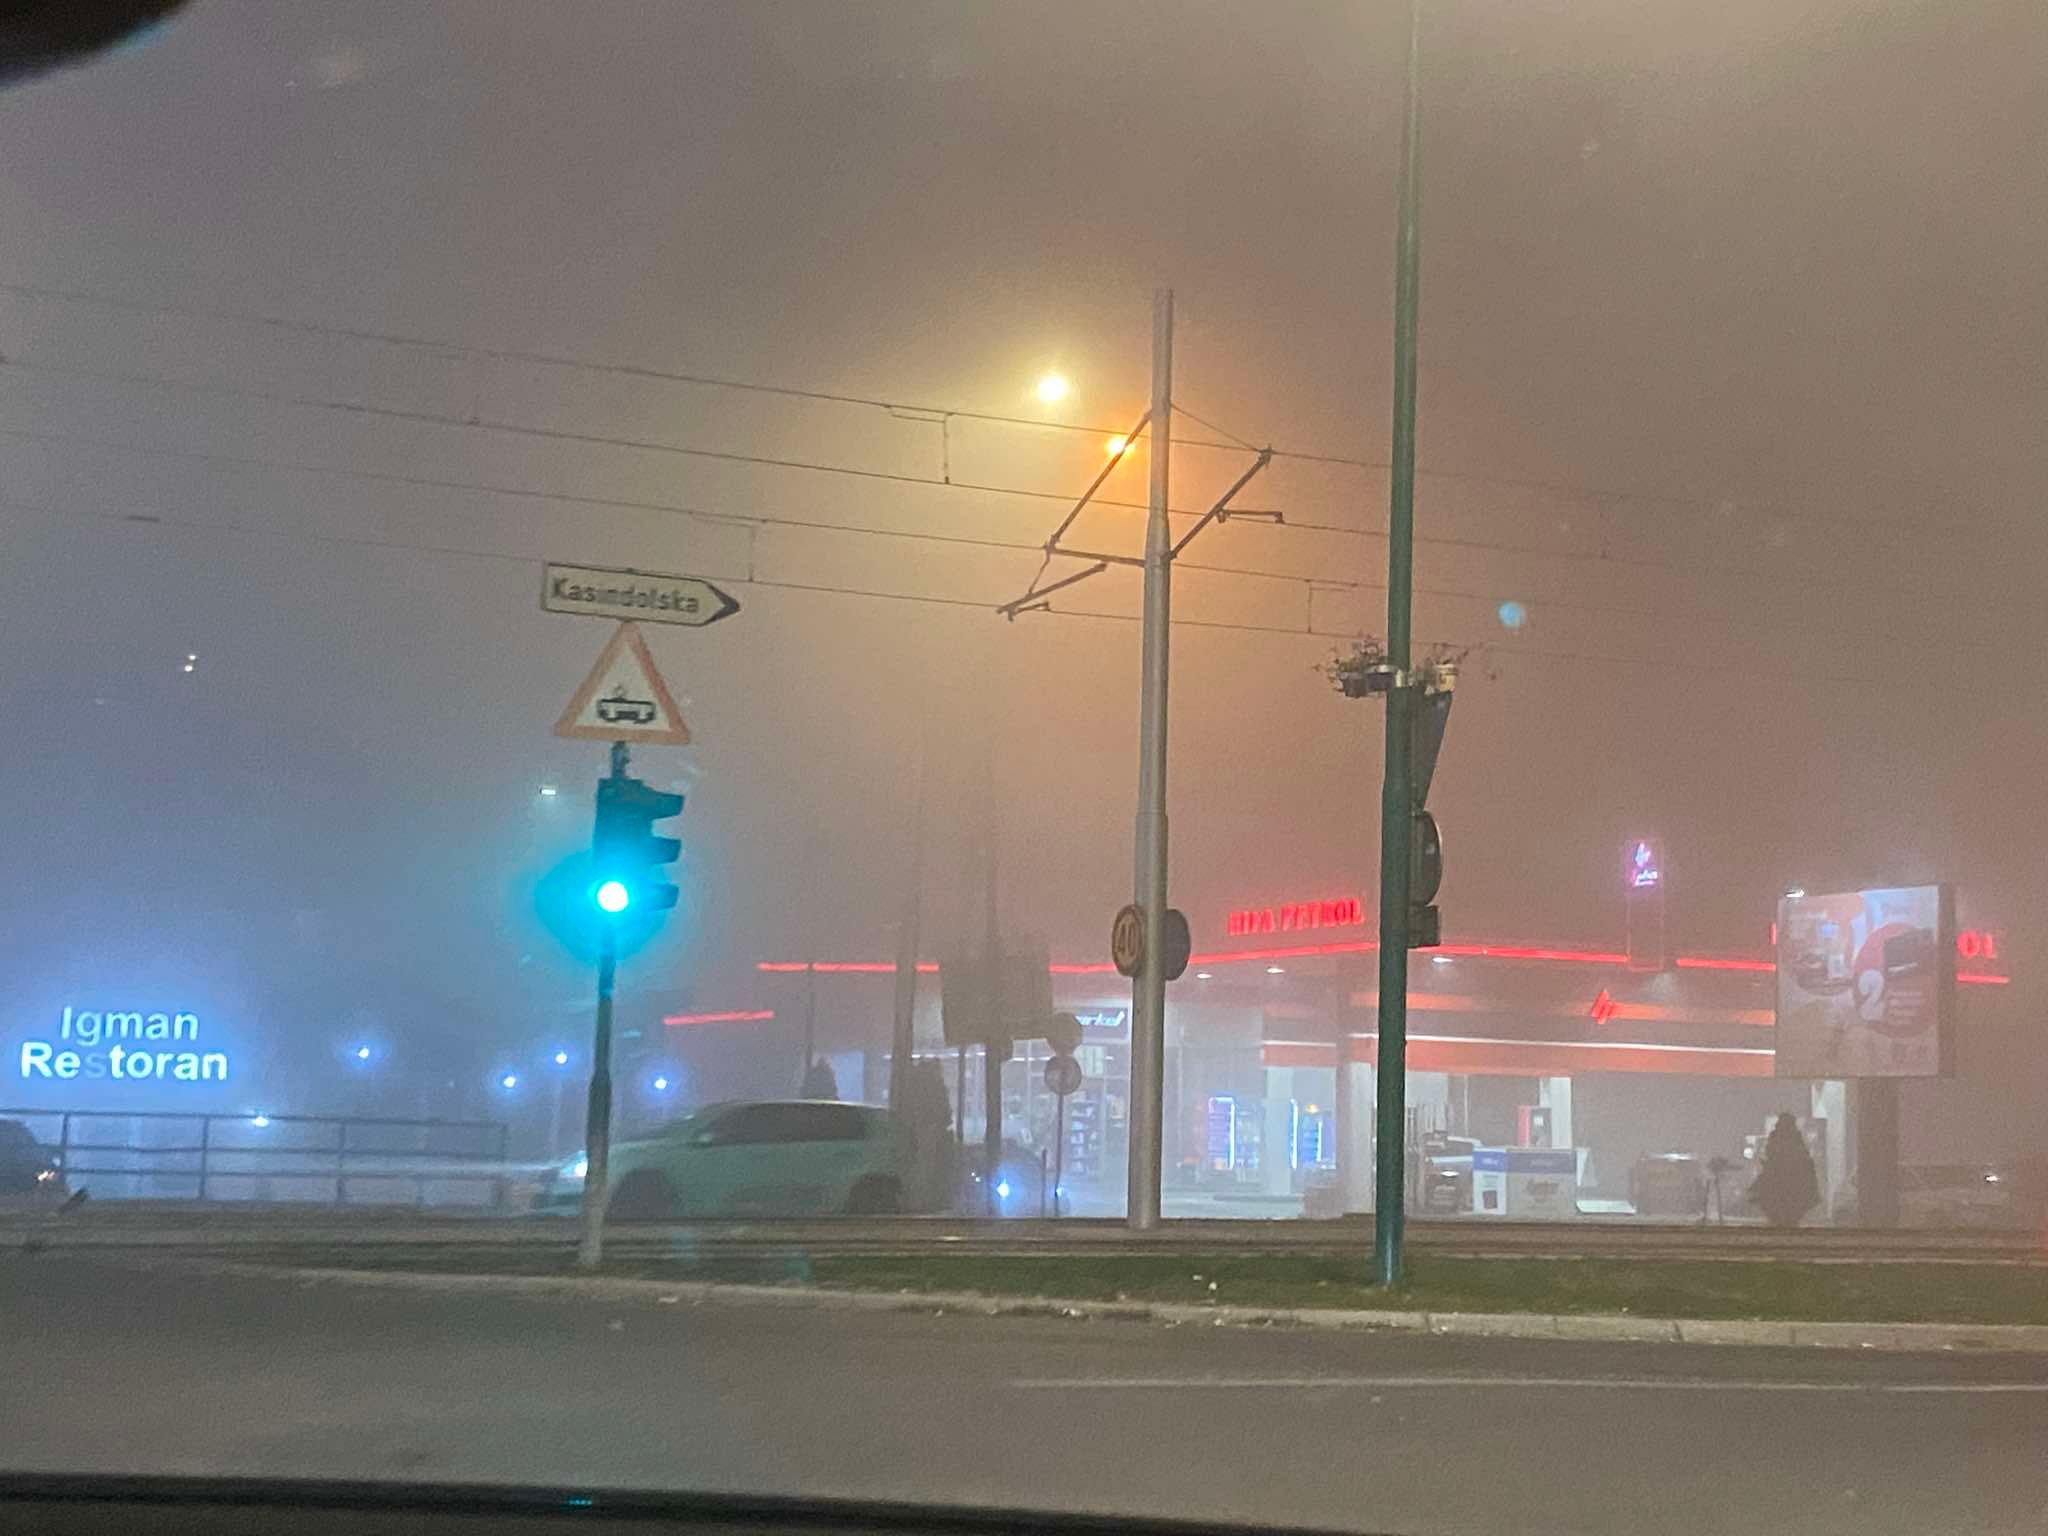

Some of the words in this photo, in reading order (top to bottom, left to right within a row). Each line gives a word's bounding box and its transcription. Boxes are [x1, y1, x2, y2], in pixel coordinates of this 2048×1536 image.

[552, 577, 699, 613] Kasindolska
[1117, 923, 1136, 956] 40
[60, 1005, 200, 1047] Igman
[20, 1041, 228, 1081] Restoran
